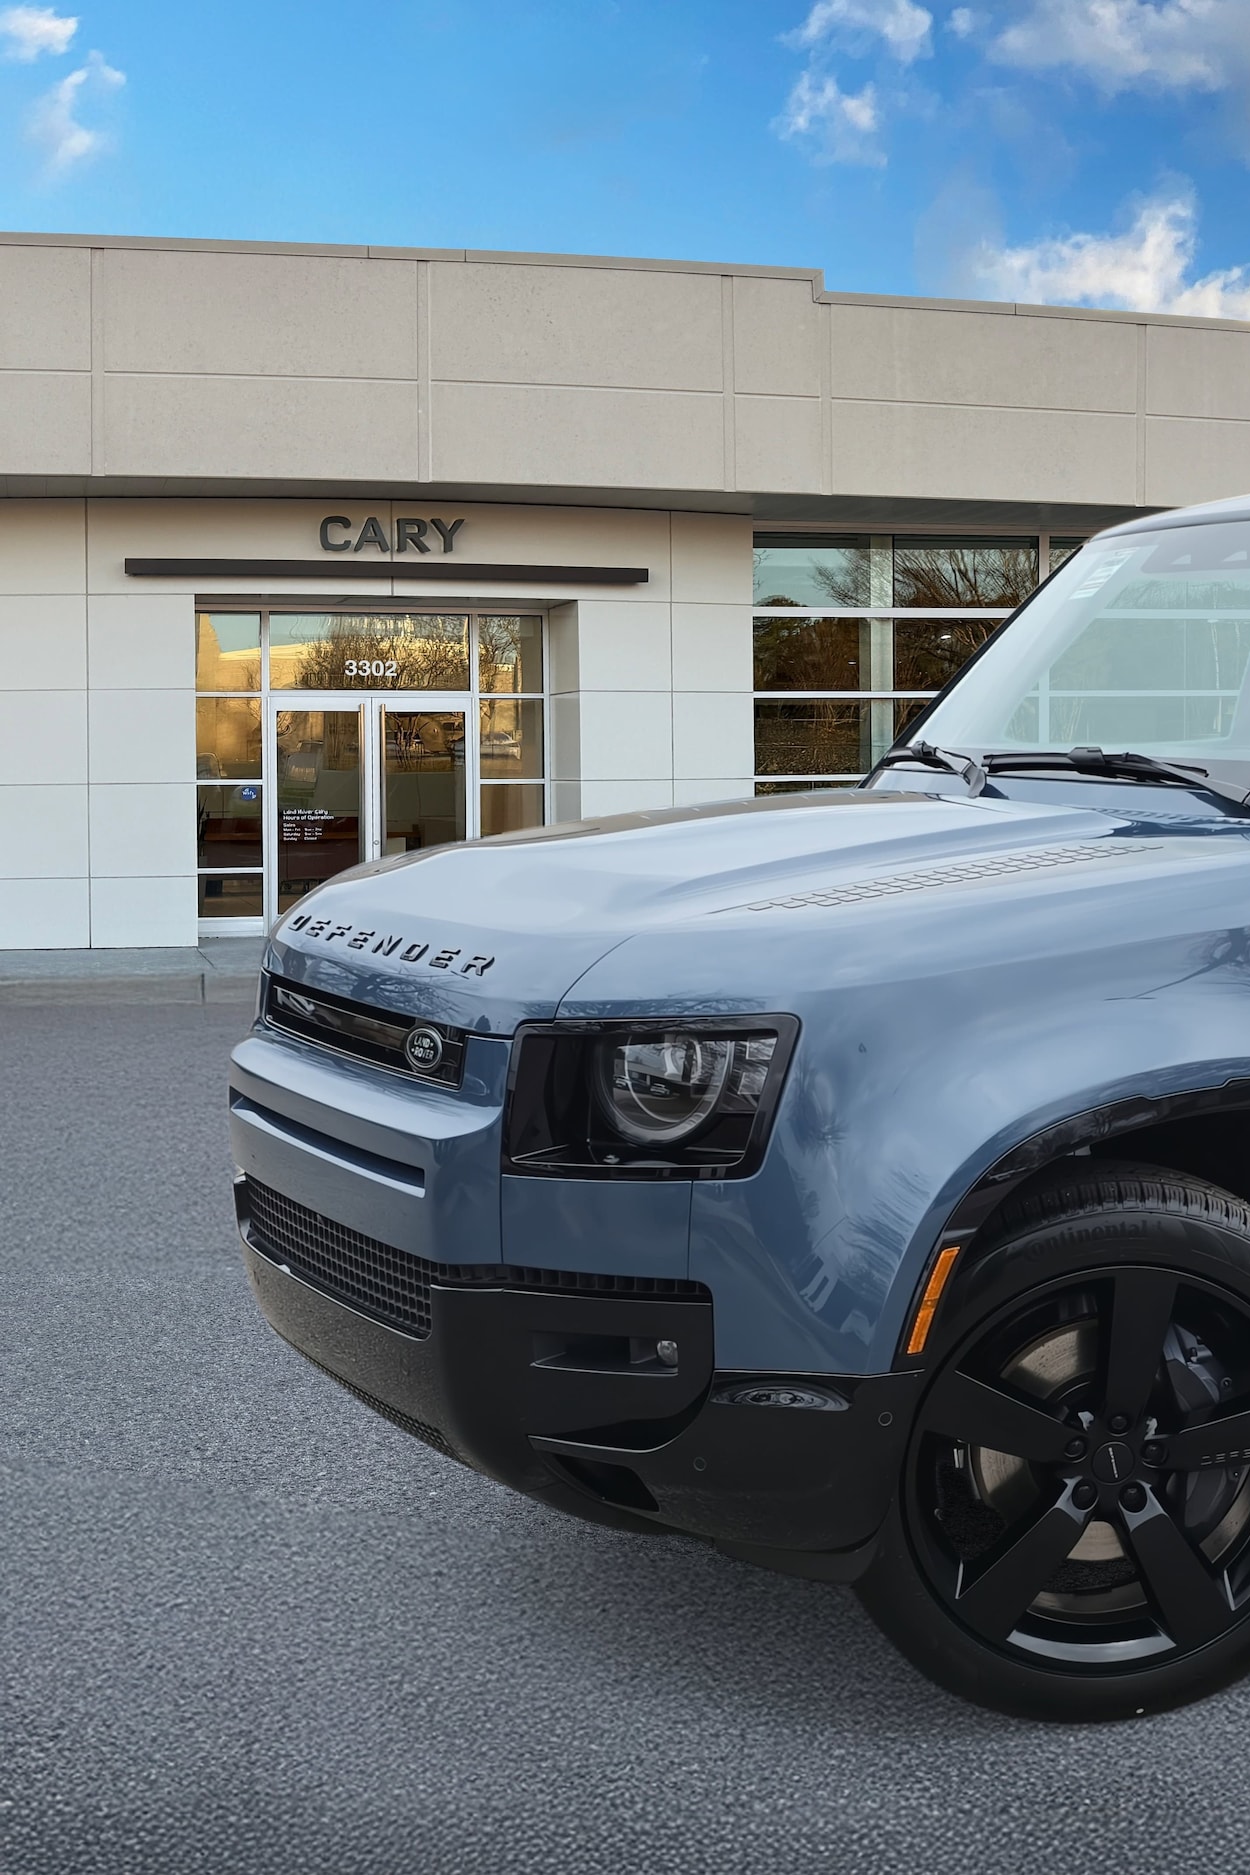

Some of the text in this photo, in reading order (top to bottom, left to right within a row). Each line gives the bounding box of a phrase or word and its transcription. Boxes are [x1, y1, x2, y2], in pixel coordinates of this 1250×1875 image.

[319, 515, 465, 554] CARY
[344, 659, 398, 677] 3302
[288, 915, 496, 977] DEFENDER
